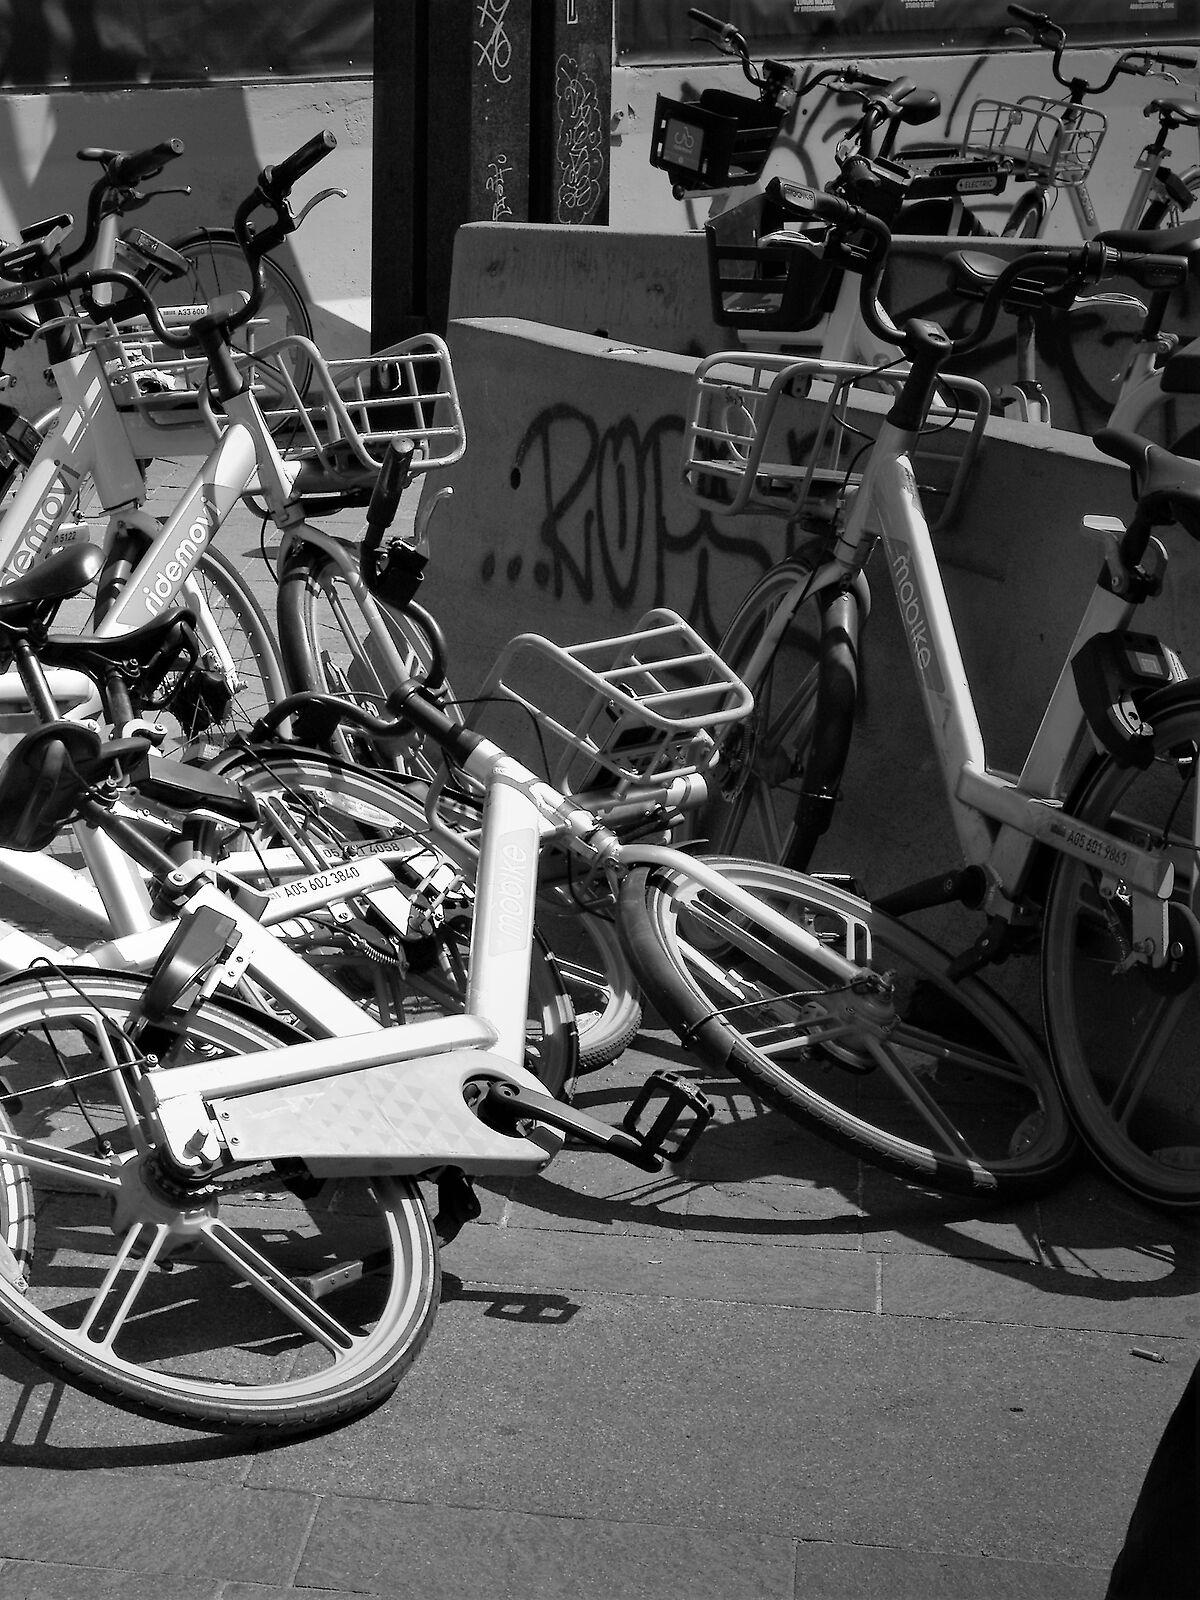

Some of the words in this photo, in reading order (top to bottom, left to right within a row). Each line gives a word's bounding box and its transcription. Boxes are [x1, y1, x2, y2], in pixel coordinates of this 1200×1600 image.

[142, 496, 221, 617] ridemovi
[369, 842, 401, 854] 4058
[284, 883, 308, 899] A05
[308, 876, 332, 892] 602
[330, 866, 361, 884] 3840
[497, 843, 528, 940] mobike
